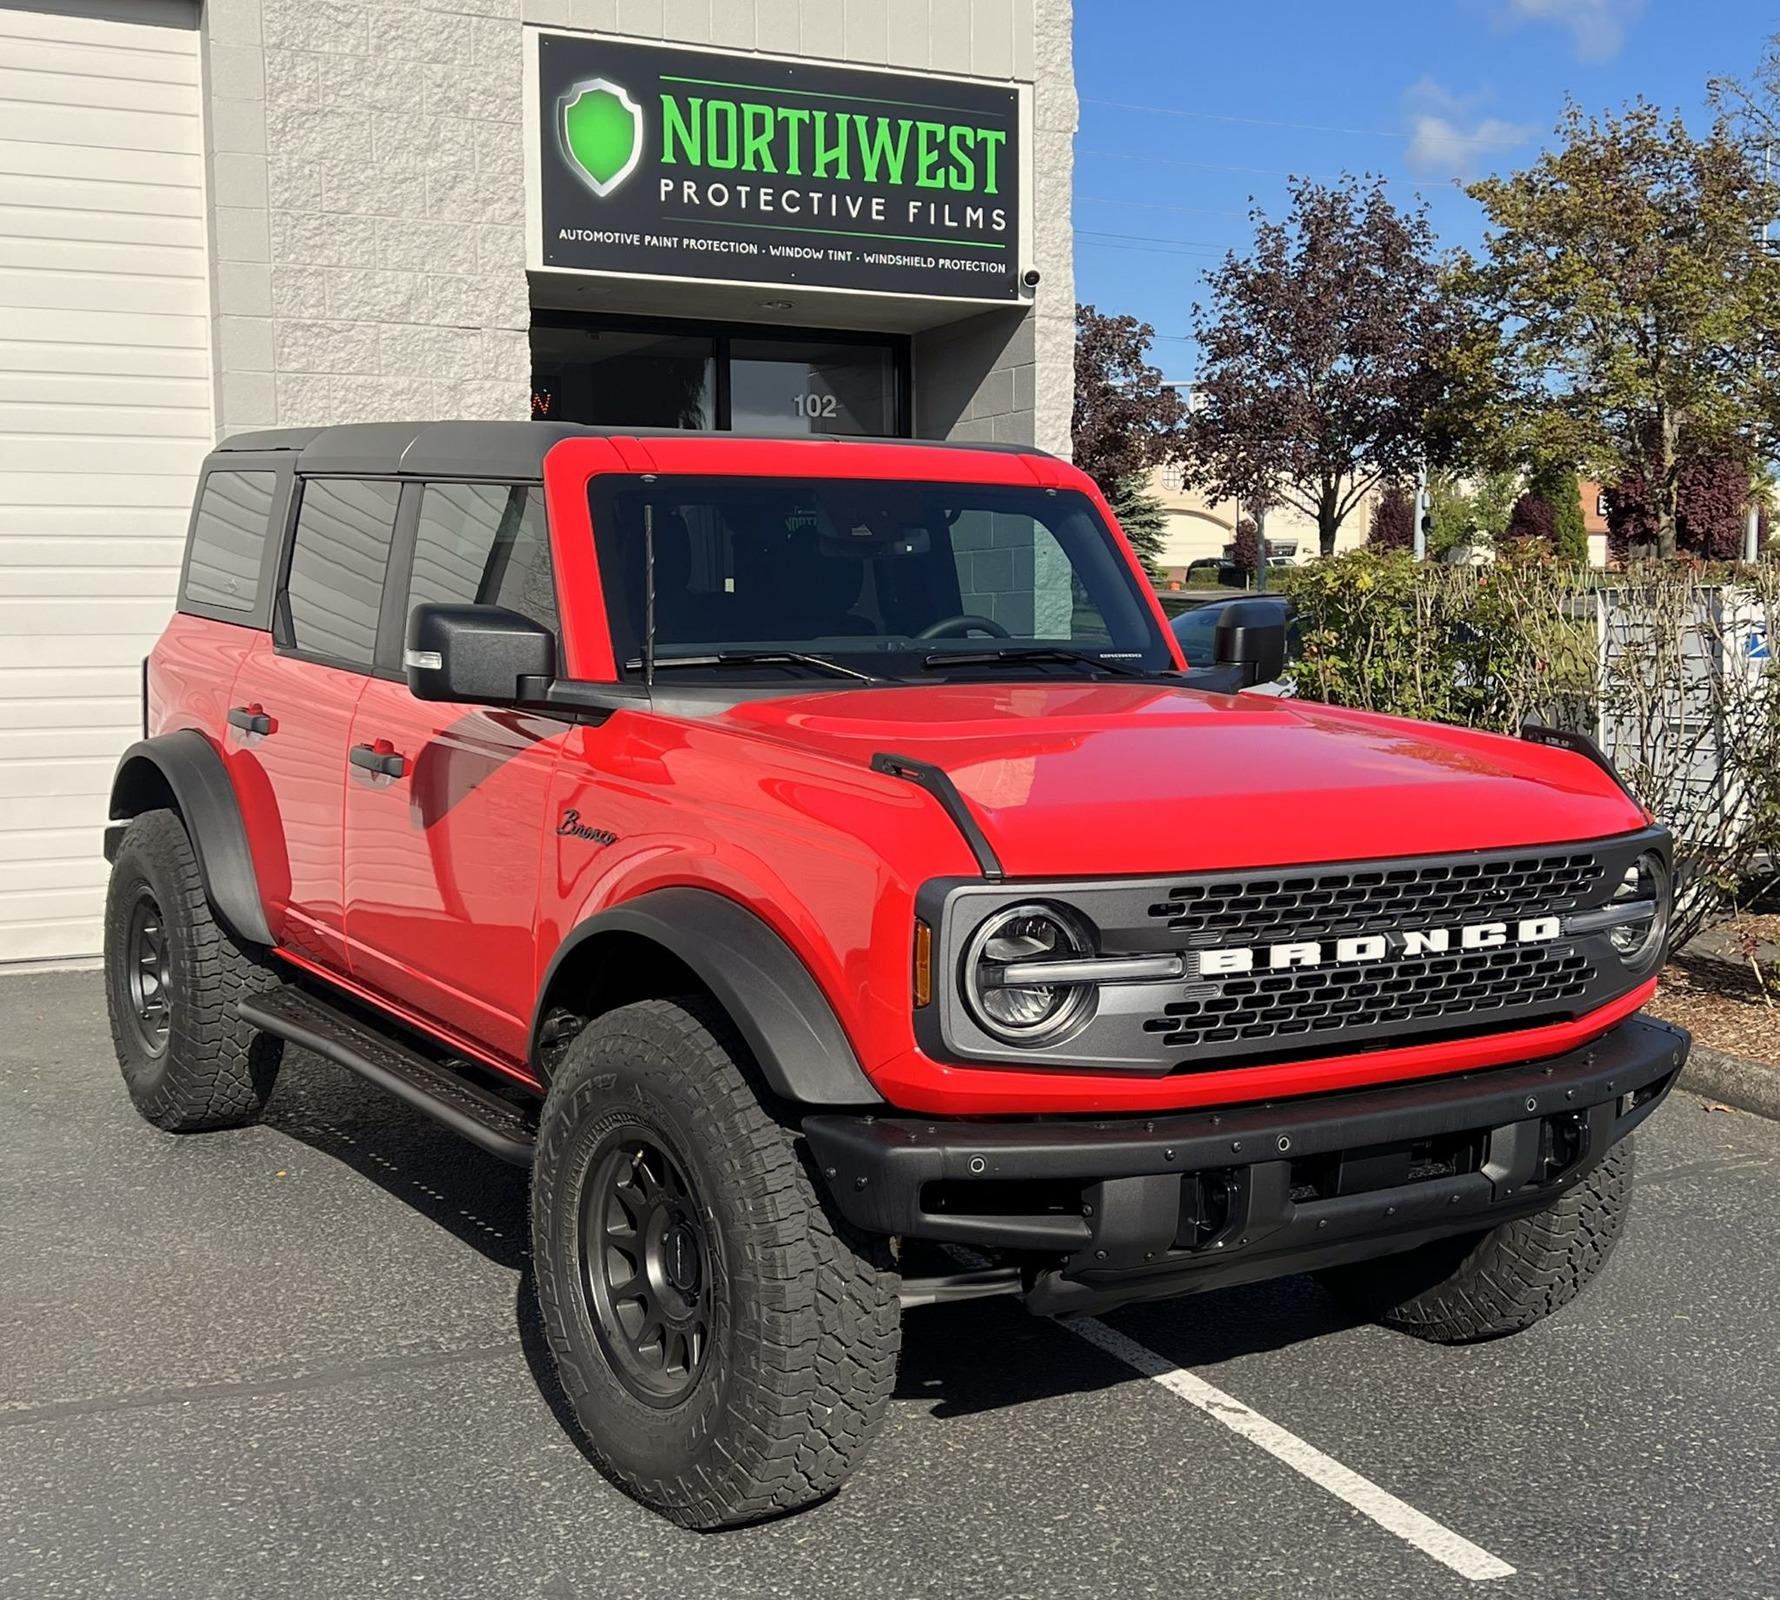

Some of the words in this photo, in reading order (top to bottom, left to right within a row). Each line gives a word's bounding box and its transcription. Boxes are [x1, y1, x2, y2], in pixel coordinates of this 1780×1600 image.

[659, 94, 1006, 195] NORTHWEST
[660, 178, 886, 221] PROTECTIVE
[908, 201, 1007, 232] FILMS
[559, 228, 640, 246] AUTOMOTIVE
[644, 235, 679, 249] PAINT
[683, 238, 758, 255] PROTECTION
[769, 244, 824, 260] WINDOW
[827, 249, 853, 262] TINT
[863, 252, 936, 269] WINDSHIELD
[938, 257, 1006, 274] PROTECTION
[793, 393, 837, 418] 102
[556, 808, 619, 847] Bronco
[1199, 915, 1561, 977] BRONCO
